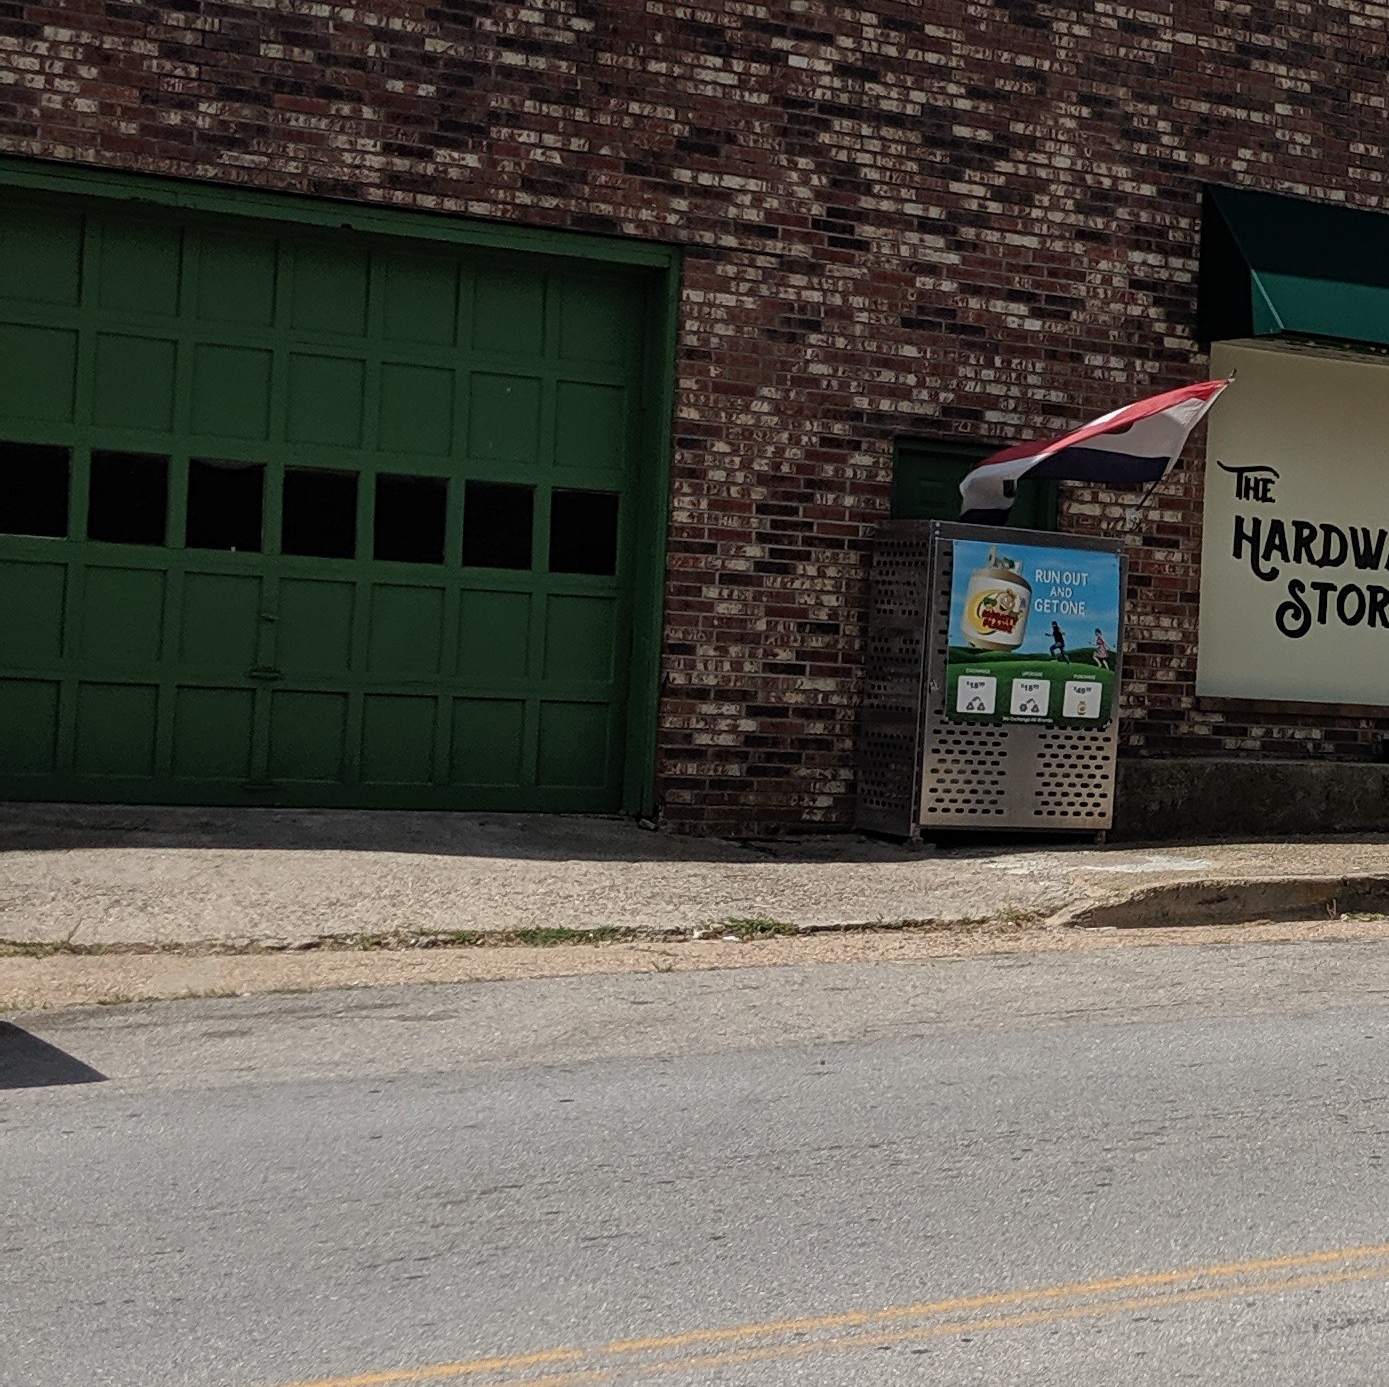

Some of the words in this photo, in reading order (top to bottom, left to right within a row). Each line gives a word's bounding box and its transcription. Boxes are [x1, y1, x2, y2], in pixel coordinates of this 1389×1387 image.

[1216, 460, 1280, 503] THE
[1035, 569, 1060, 584] RUN
[1063, 571, 1089, 586] OUT
[1050, 586, 1073, 598] AND
[1034, 598, 1060, 613] GET
[1060, 600, 1086, 615] ONE
